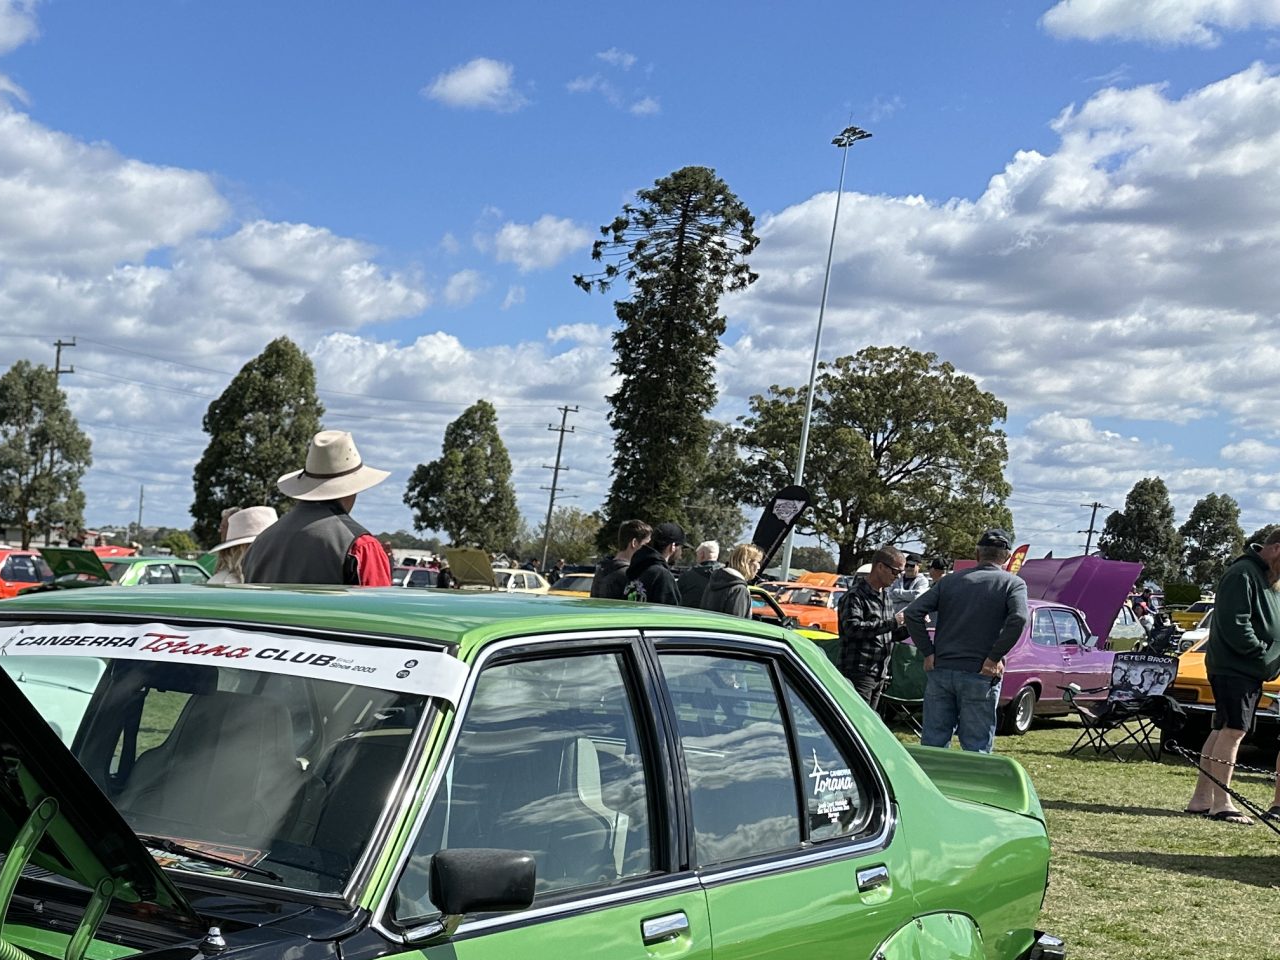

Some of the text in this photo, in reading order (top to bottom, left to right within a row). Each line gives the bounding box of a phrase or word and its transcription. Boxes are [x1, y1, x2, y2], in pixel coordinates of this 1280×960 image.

[16, 635, 139, 648] CANBERRA
[139, 632, 254, 660] Torana
[254, 647, 337, 667] CLUB
[329, 662, 352, 670] Since
[1117, 654, 1173, 664] PETER BROCK
[809, 771, 853, 795] Torana
